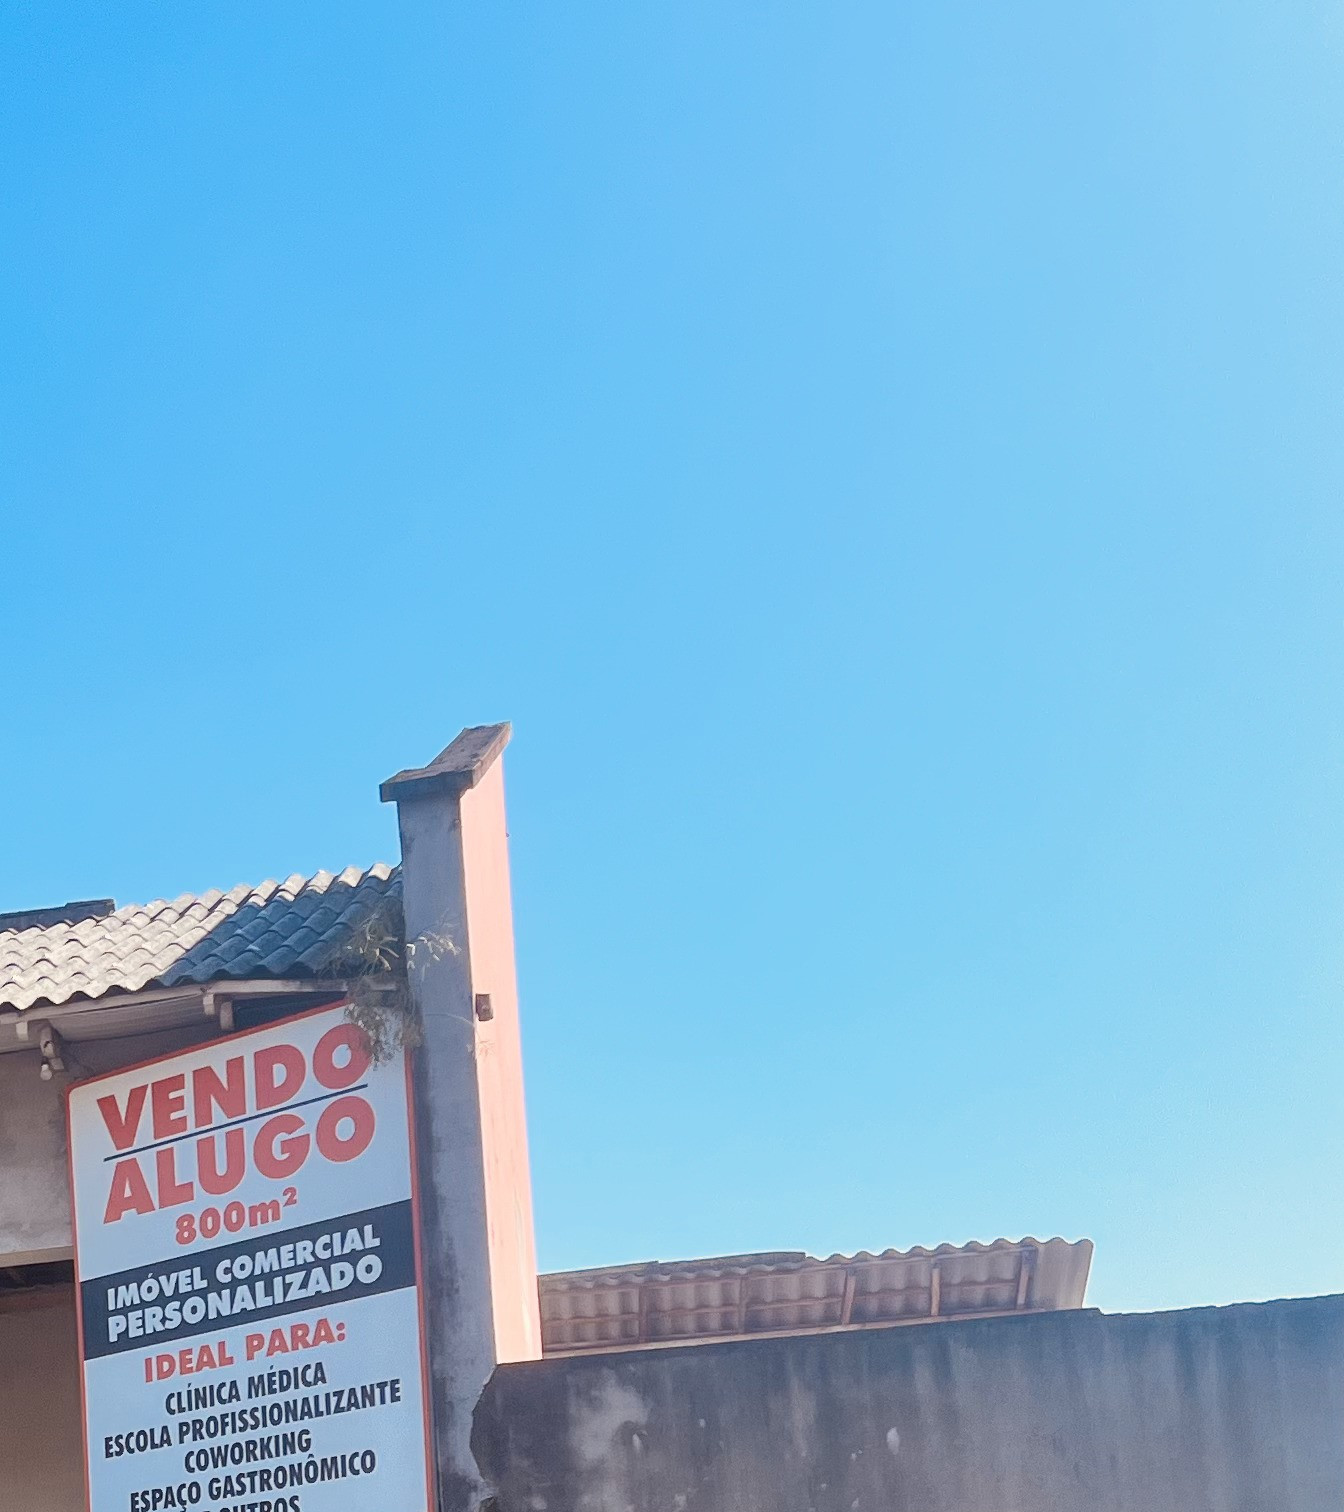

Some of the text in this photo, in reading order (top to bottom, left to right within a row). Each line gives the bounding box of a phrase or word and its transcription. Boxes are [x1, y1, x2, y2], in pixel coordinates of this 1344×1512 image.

[96, 1023, 372, 1151] VENDO
[103, 1095, 376, 1224] ALUGO
[175, 1186, 298, 1245] 800m²
[107, 1224, 381, 1312] IMÓVEL COMERCIAL
[107, 1254, 383, 1343] PERSONALIZADO
[144, 1317, 346, 1383] IDEAL PARA:
[104, 1378, 402, 1459] ESCOLA PROFISSIONALIZANTE
[165, 1361, 327, 1416] CLÍNICA MÉDICA
[184, 1429, 312, 1474] COWORKING
[208, 1449, 376, 1501] GASTRONÔMICO
